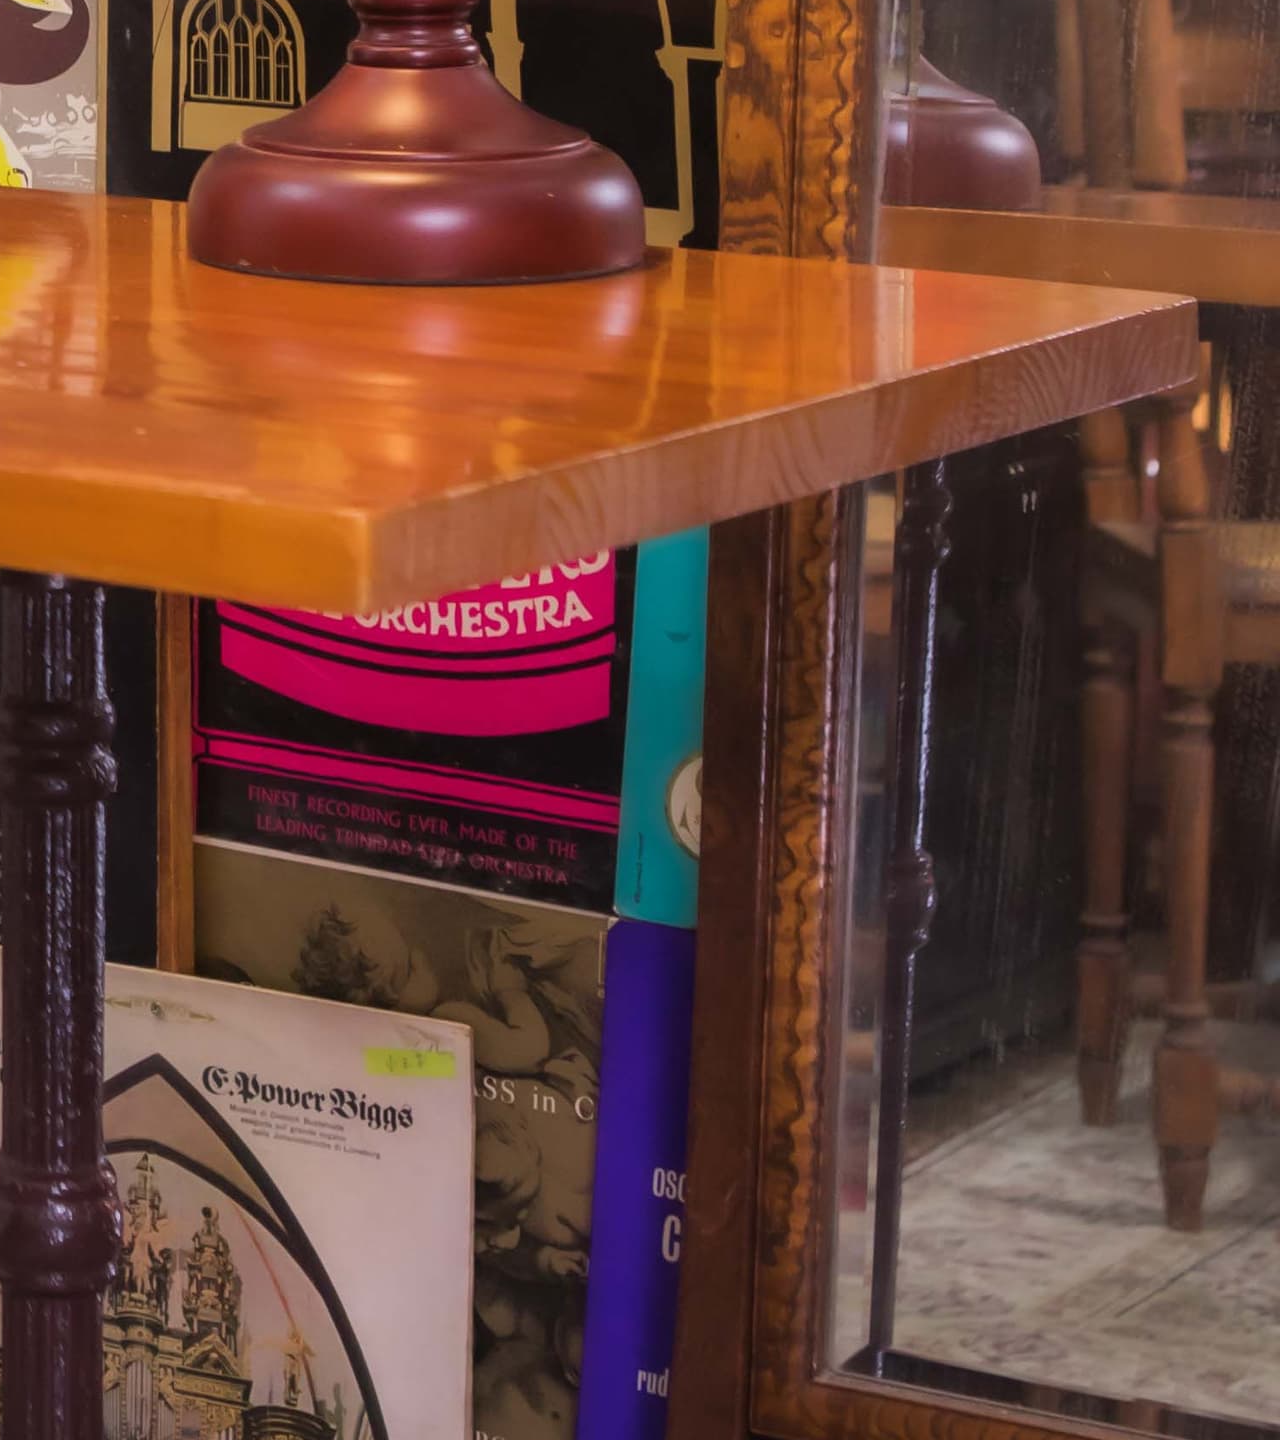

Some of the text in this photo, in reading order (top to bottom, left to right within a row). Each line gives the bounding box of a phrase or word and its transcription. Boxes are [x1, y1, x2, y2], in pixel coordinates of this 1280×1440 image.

[247, 784, 578, 860] FINEST RECORDING EVER MADE OF THE
[255, 814, 569, 885] LEADING TRINIDAD ORCHESTRA
[329, 1087, 414, 1134] Biggs
[533, 1086, 557, 1113] in
